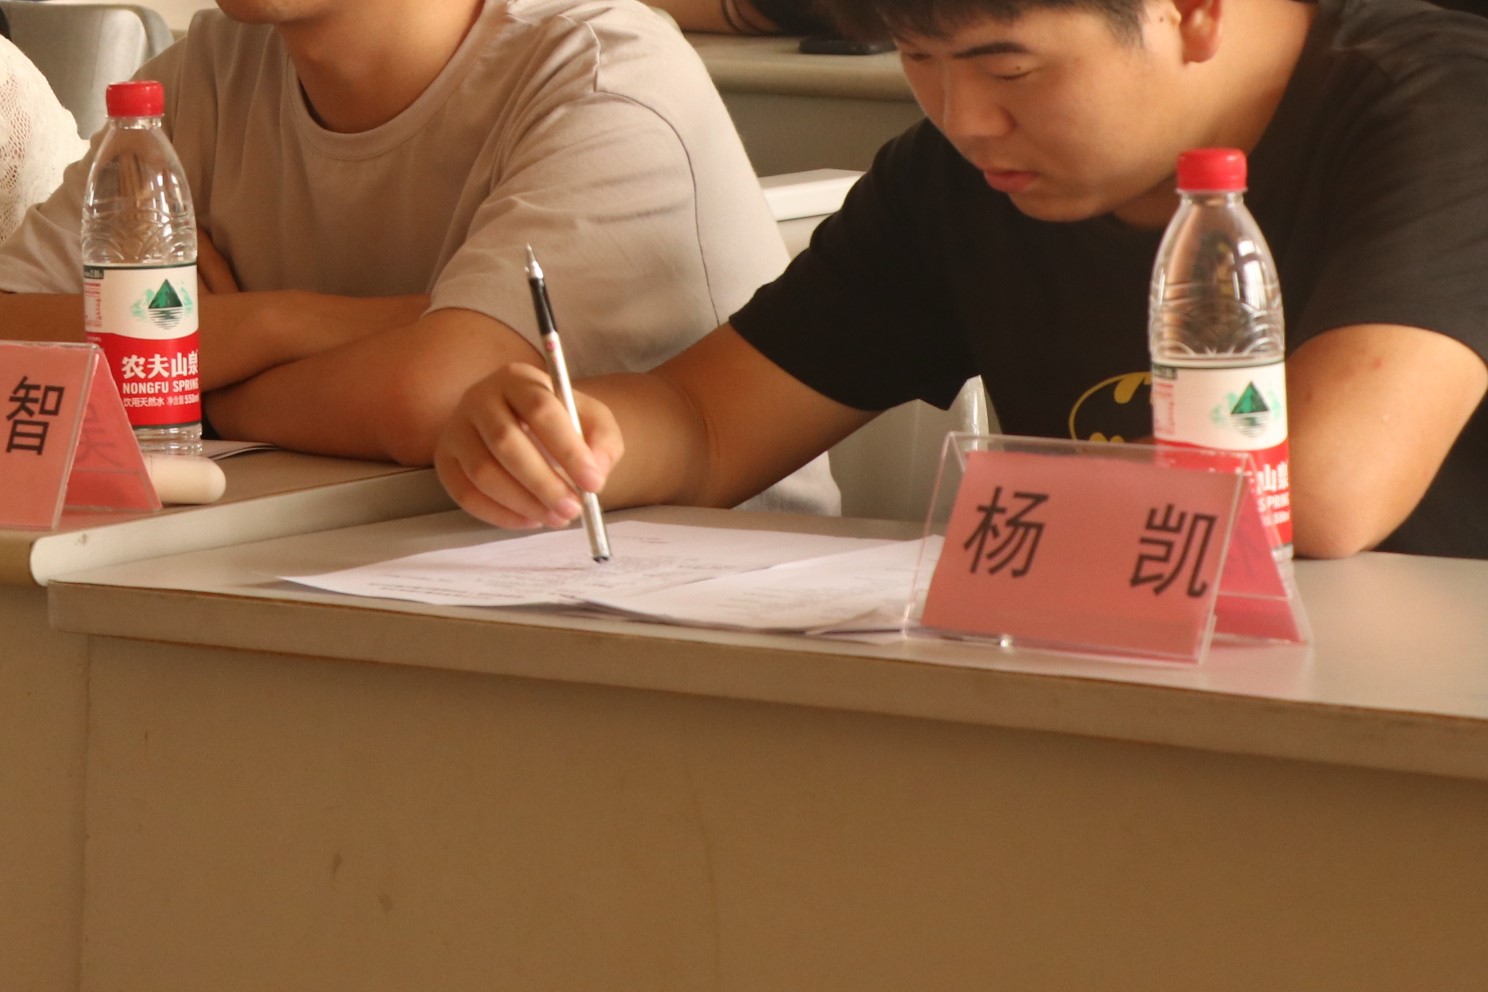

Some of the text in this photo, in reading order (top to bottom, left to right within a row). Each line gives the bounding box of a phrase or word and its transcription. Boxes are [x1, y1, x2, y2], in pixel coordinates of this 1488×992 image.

[121, 351, 199, 379] 农夫山泉
[123, 381, 169, 394] NONGFU
[963, 486, 1217, 598] 杨 凯
